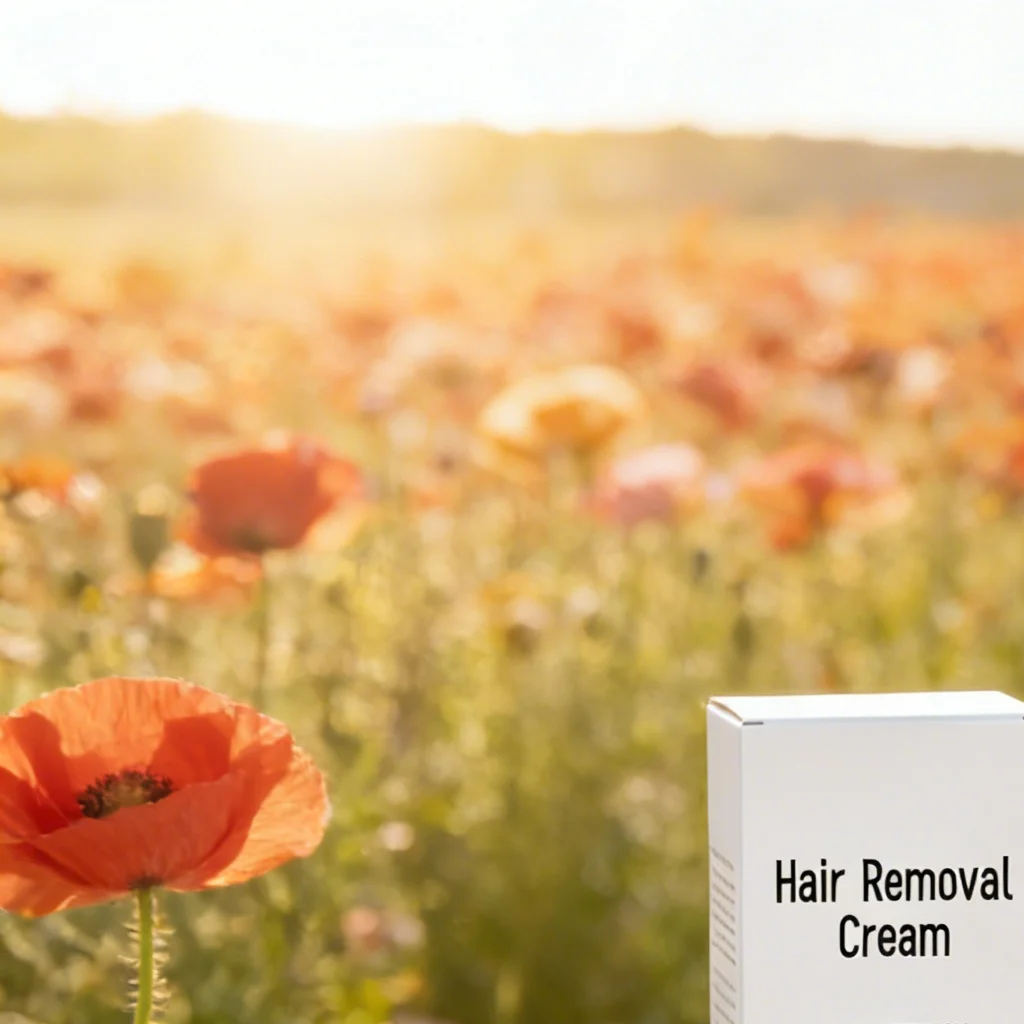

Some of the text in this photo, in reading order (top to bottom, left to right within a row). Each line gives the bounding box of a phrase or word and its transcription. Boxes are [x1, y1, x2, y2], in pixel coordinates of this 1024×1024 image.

[775, 855, 1014, 904] Hair Removal
[839, 914, 951, 959] Cream
